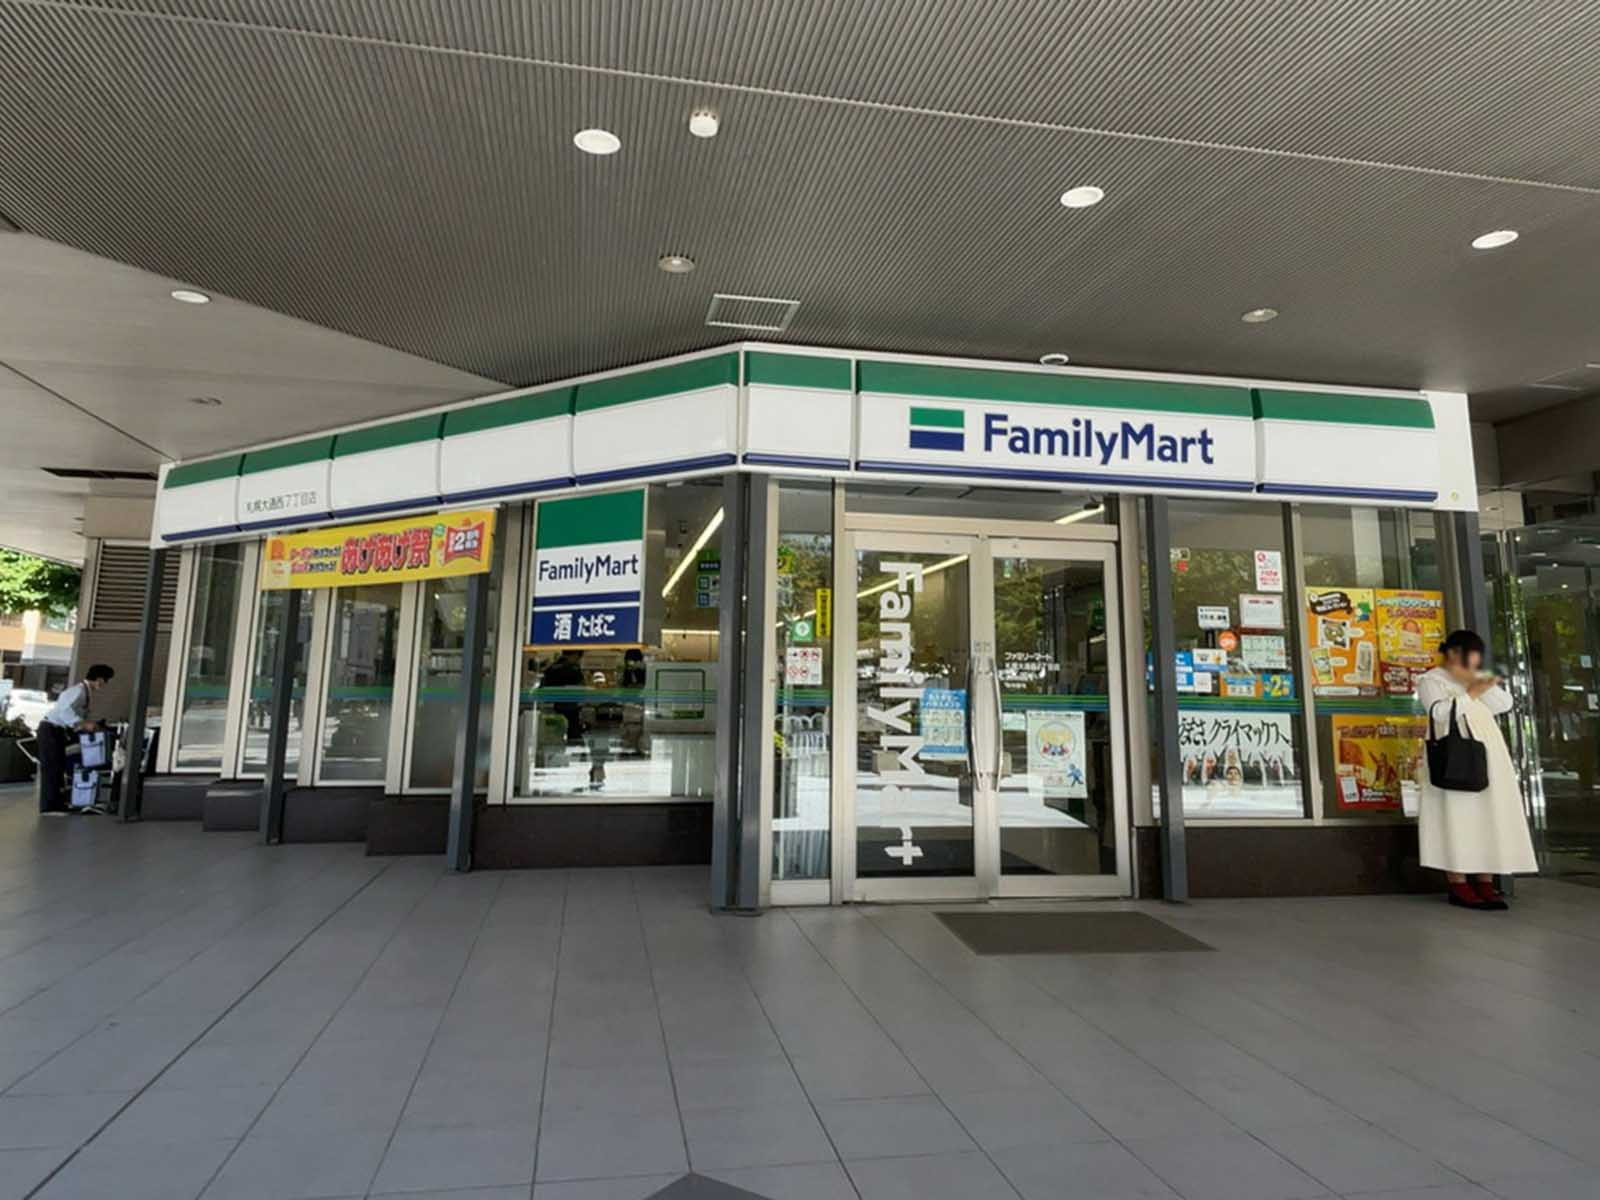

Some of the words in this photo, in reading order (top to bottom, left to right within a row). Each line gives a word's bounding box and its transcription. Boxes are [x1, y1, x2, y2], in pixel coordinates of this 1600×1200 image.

[984, 412, 1214, 465] FamilyMart
[538, 554, 639, 584] FamilyMart
[553, 613, 573, 640] 酒
[577, 613, 616, 638] たばこ
[867, 561, 925, 866] FamilyMrt
